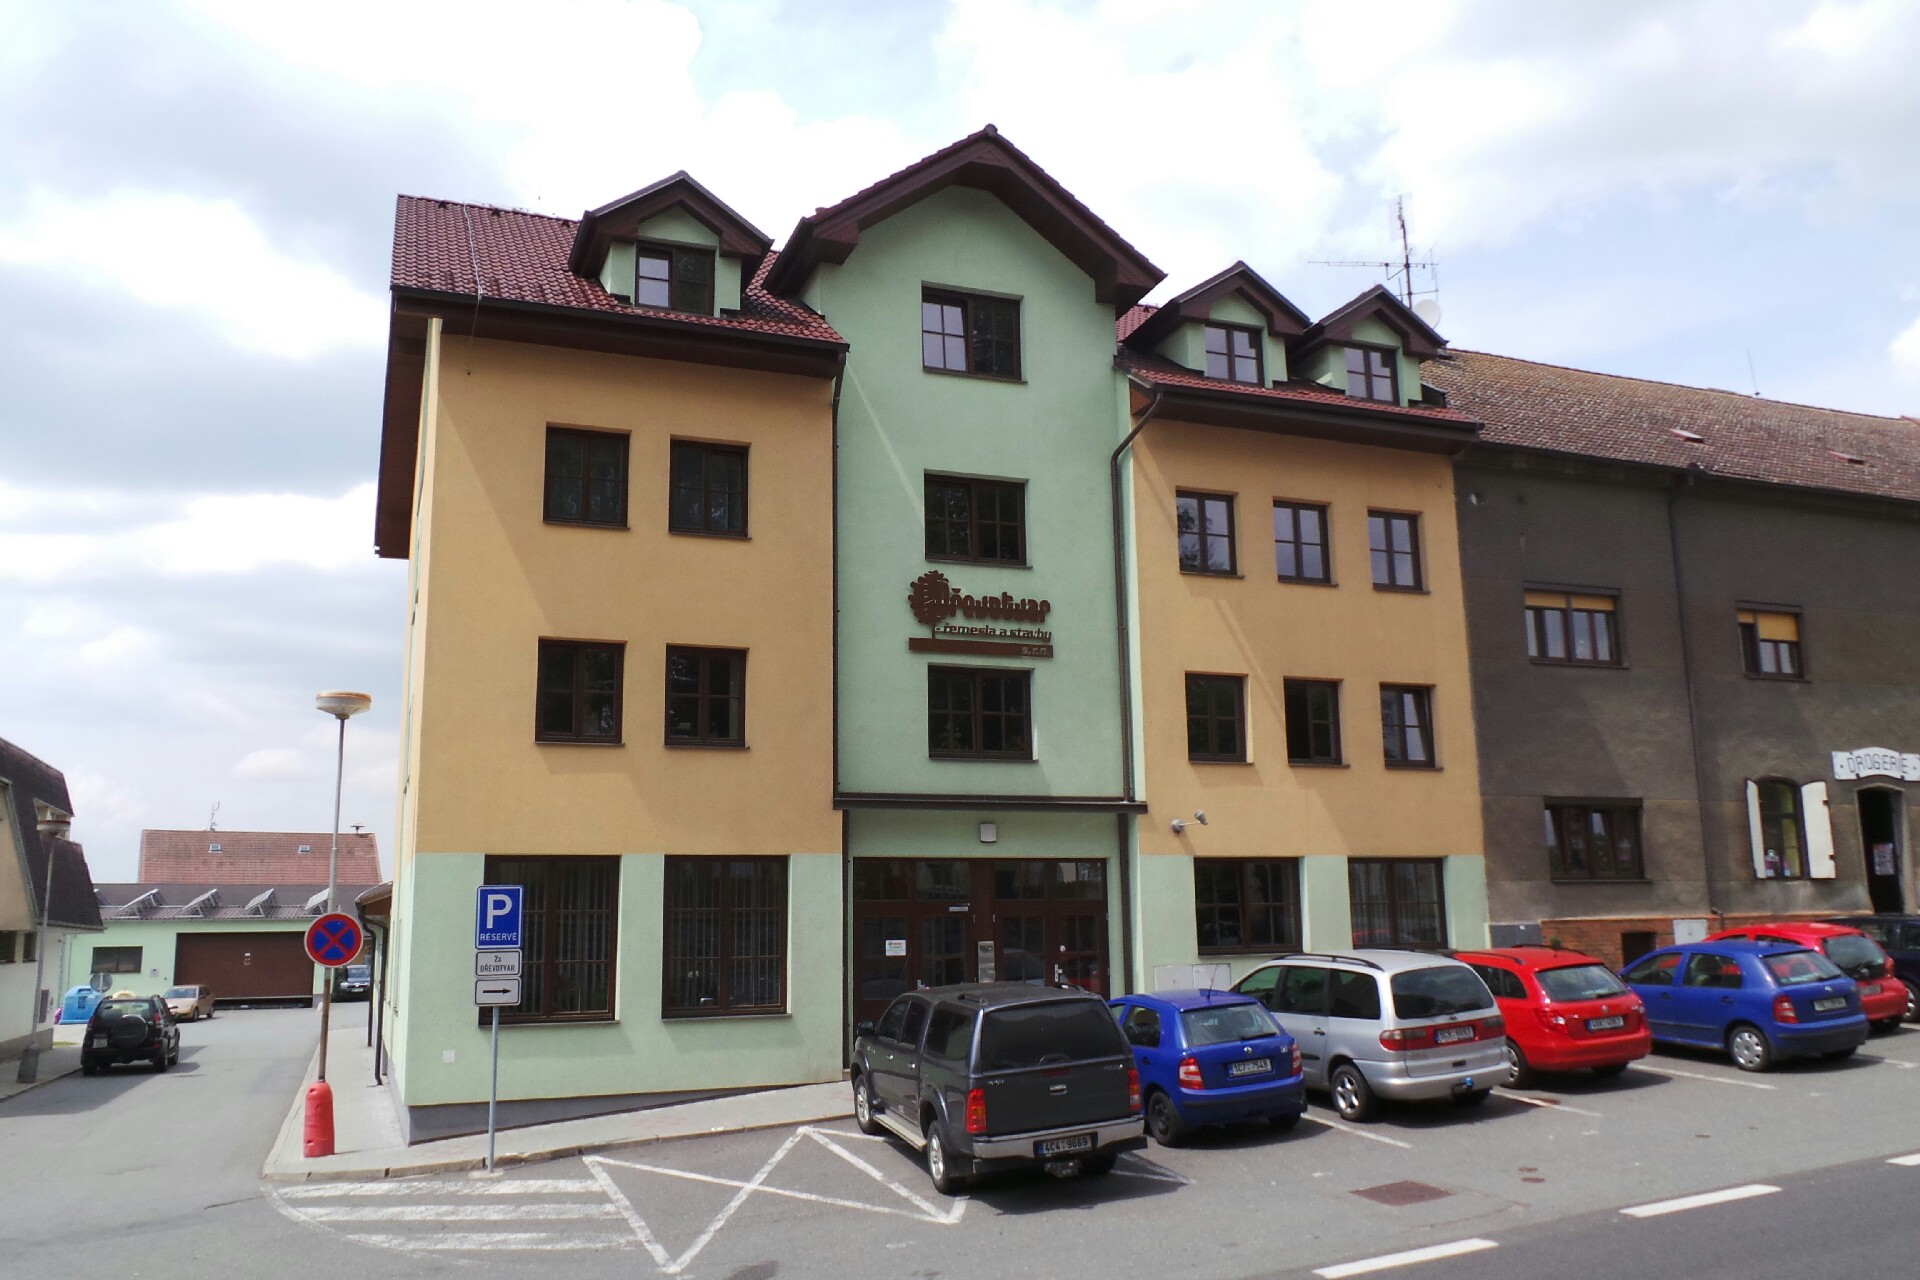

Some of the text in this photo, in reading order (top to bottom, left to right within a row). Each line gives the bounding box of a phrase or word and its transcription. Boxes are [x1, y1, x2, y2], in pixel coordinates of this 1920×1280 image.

[943, 622, 997, 637] řemesla
[999, 629, 1007, 638] a
[1010, 628, 1052, 642] stavby
[486, 893, 513, 929] P
